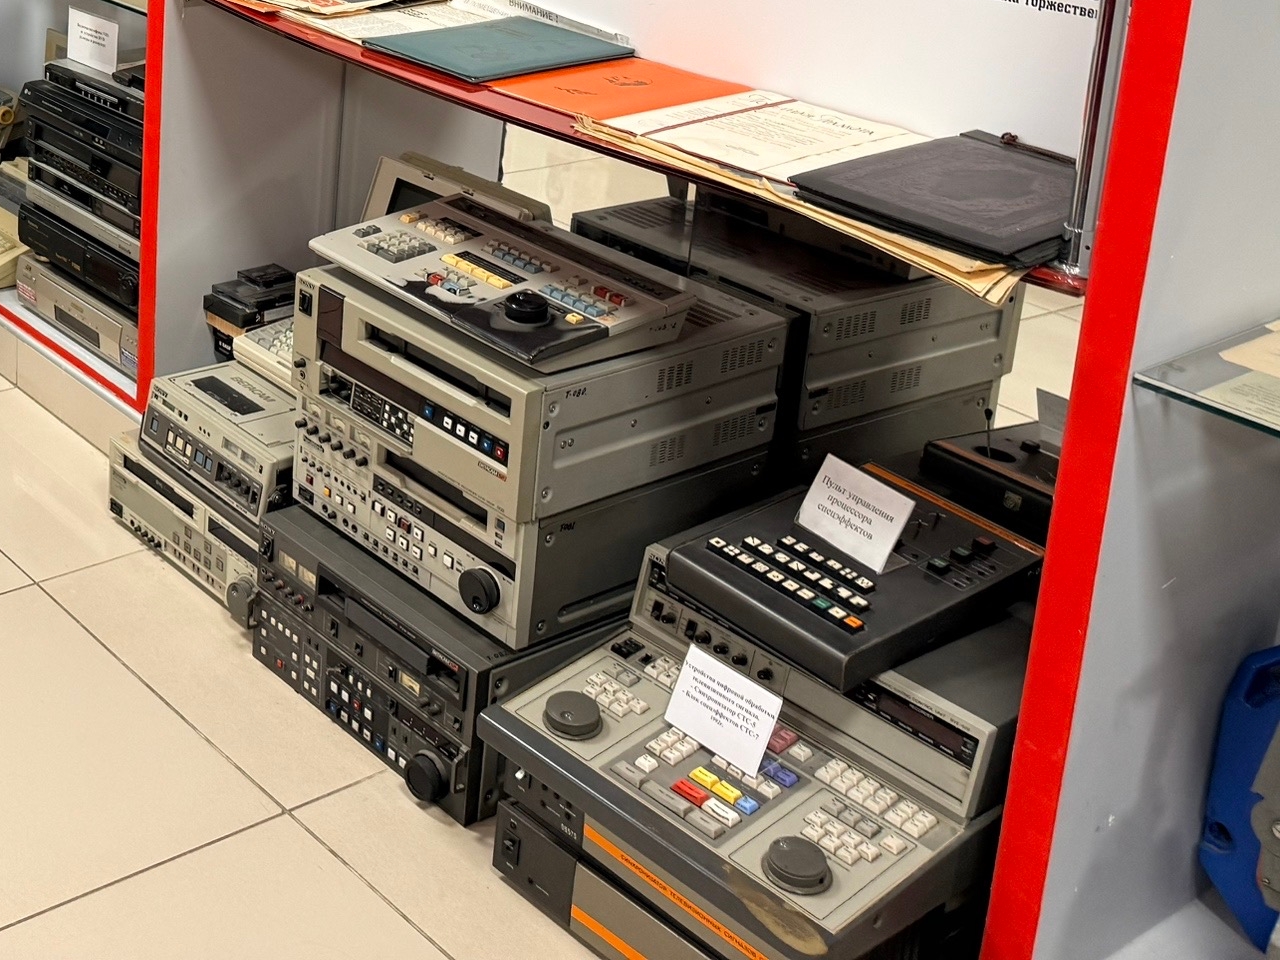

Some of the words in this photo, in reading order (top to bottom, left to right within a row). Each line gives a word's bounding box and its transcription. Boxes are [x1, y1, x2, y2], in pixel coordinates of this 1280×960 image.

[822, 474, 847, 494] Пульт
[846, 489, 895, 524] управления
[827, 494, 873, 526] процессора
[260, 521, 276, 535] SONY
[817, 502, 873, 540] спецэффектов
[648, 552, 665, 565] SON
